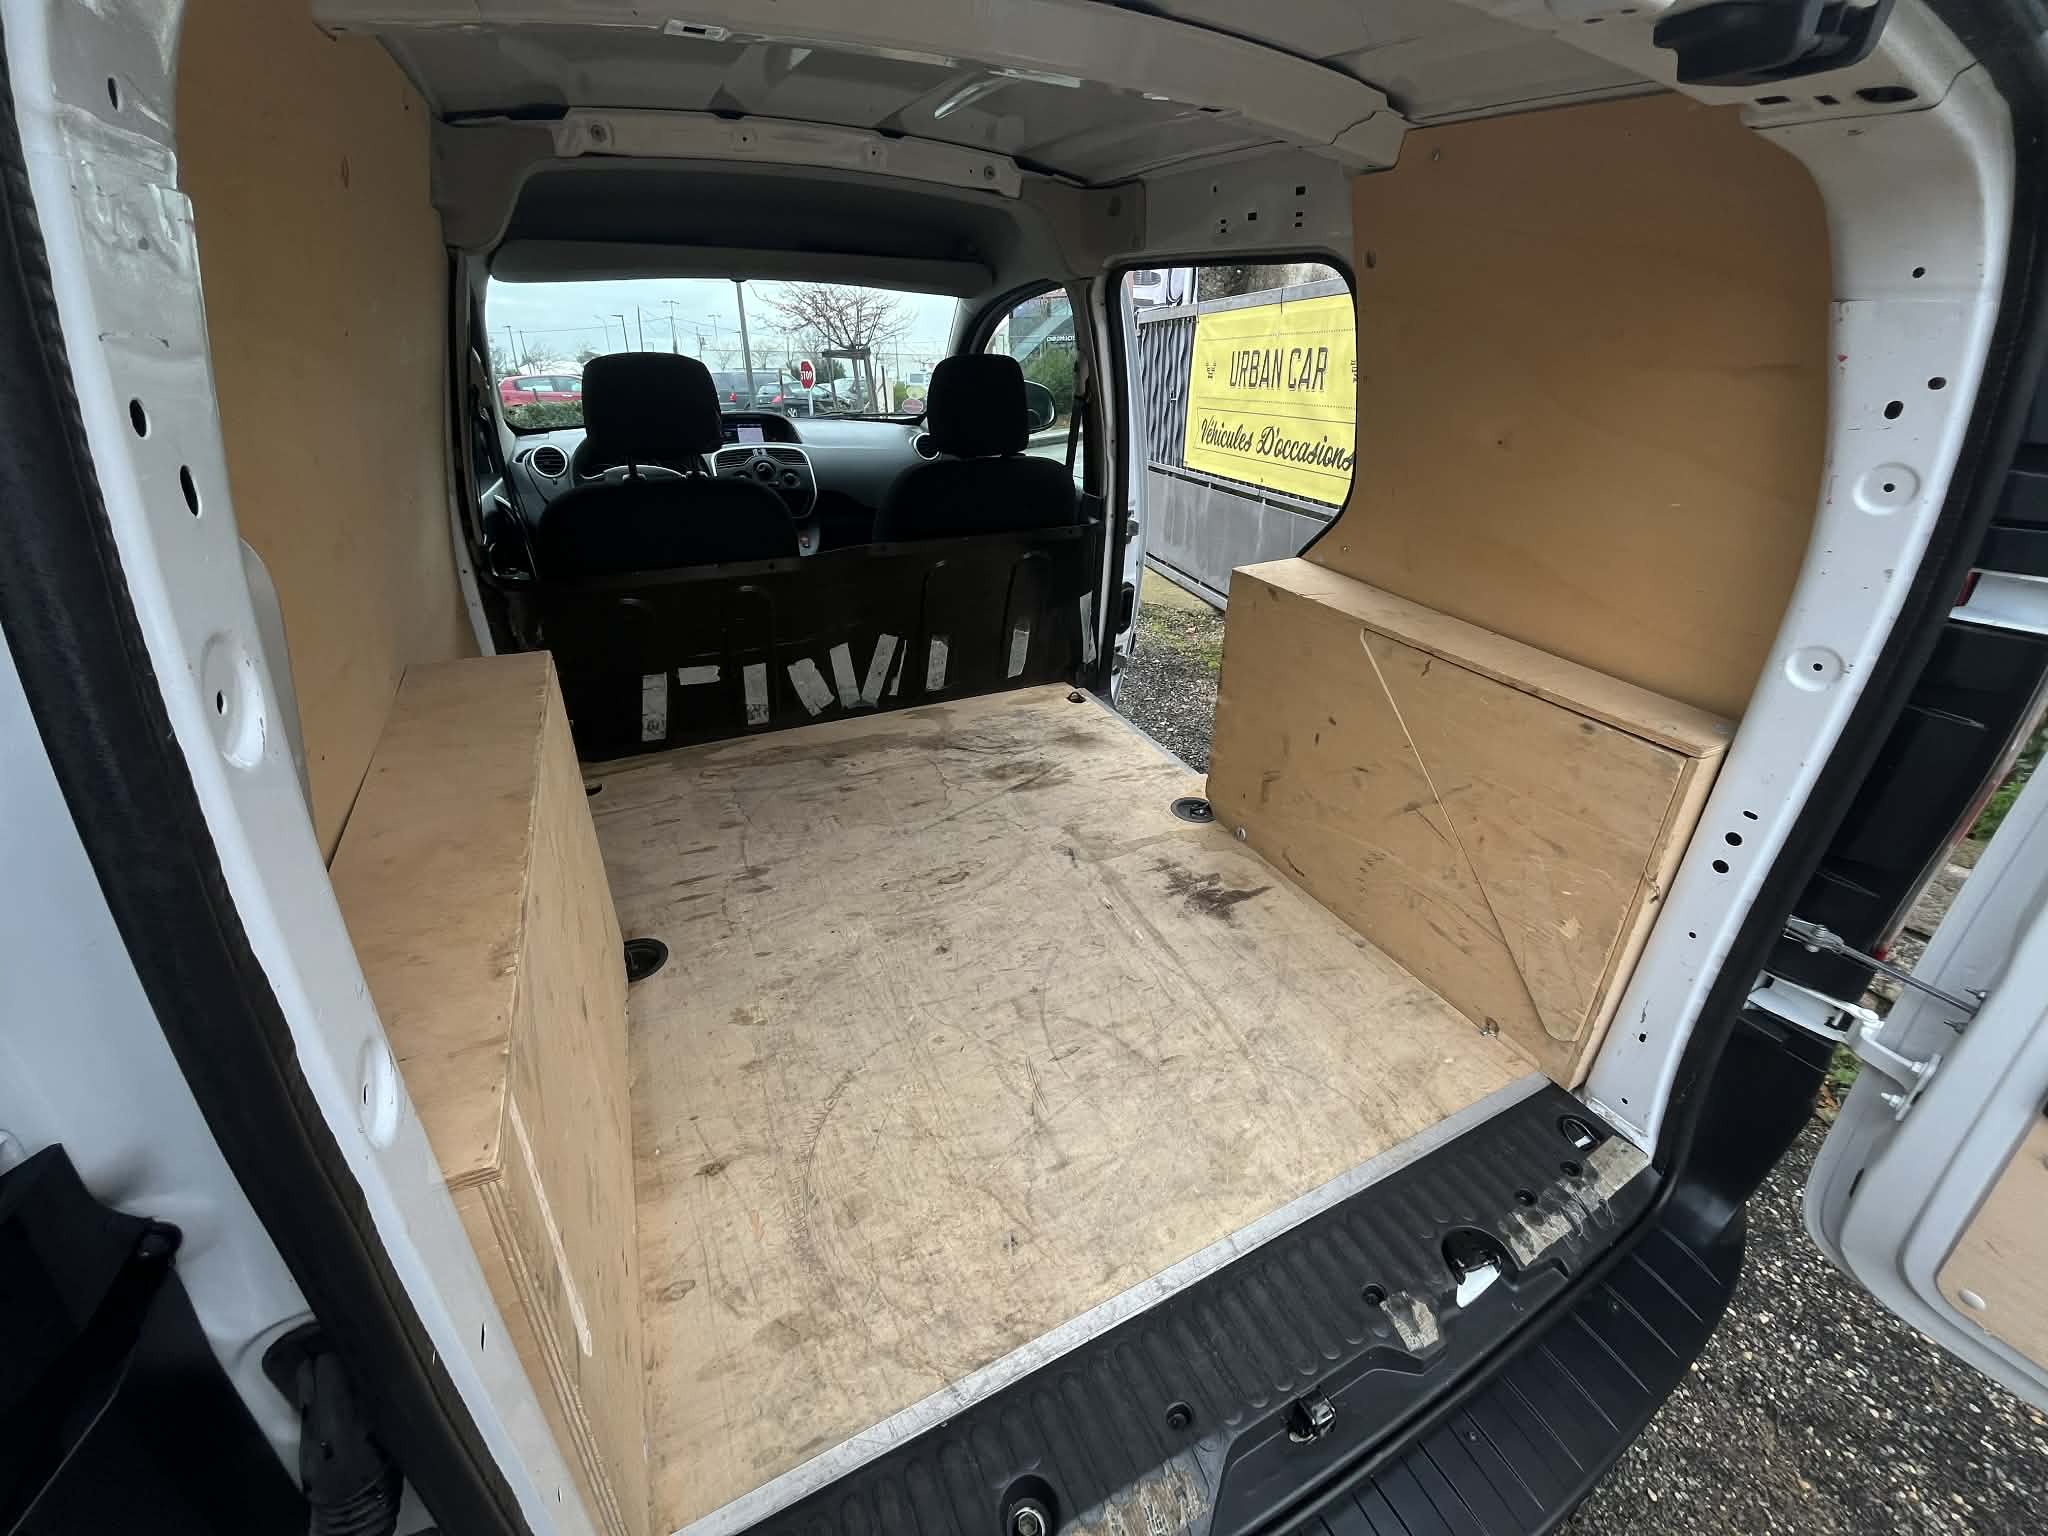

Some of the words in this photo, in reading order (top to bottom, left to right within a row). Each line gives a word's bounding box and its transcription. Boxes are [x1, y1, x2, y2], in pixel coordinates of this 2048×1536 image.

[800, 370, 812, 381] STOP
[1230, 348, 1283, 390] URBAN
[1288, 347, 1328, 391] CAR
[1201, 415, 1253, 453] Véhicules
[1256, 425, 1355, 472] D'occasions
